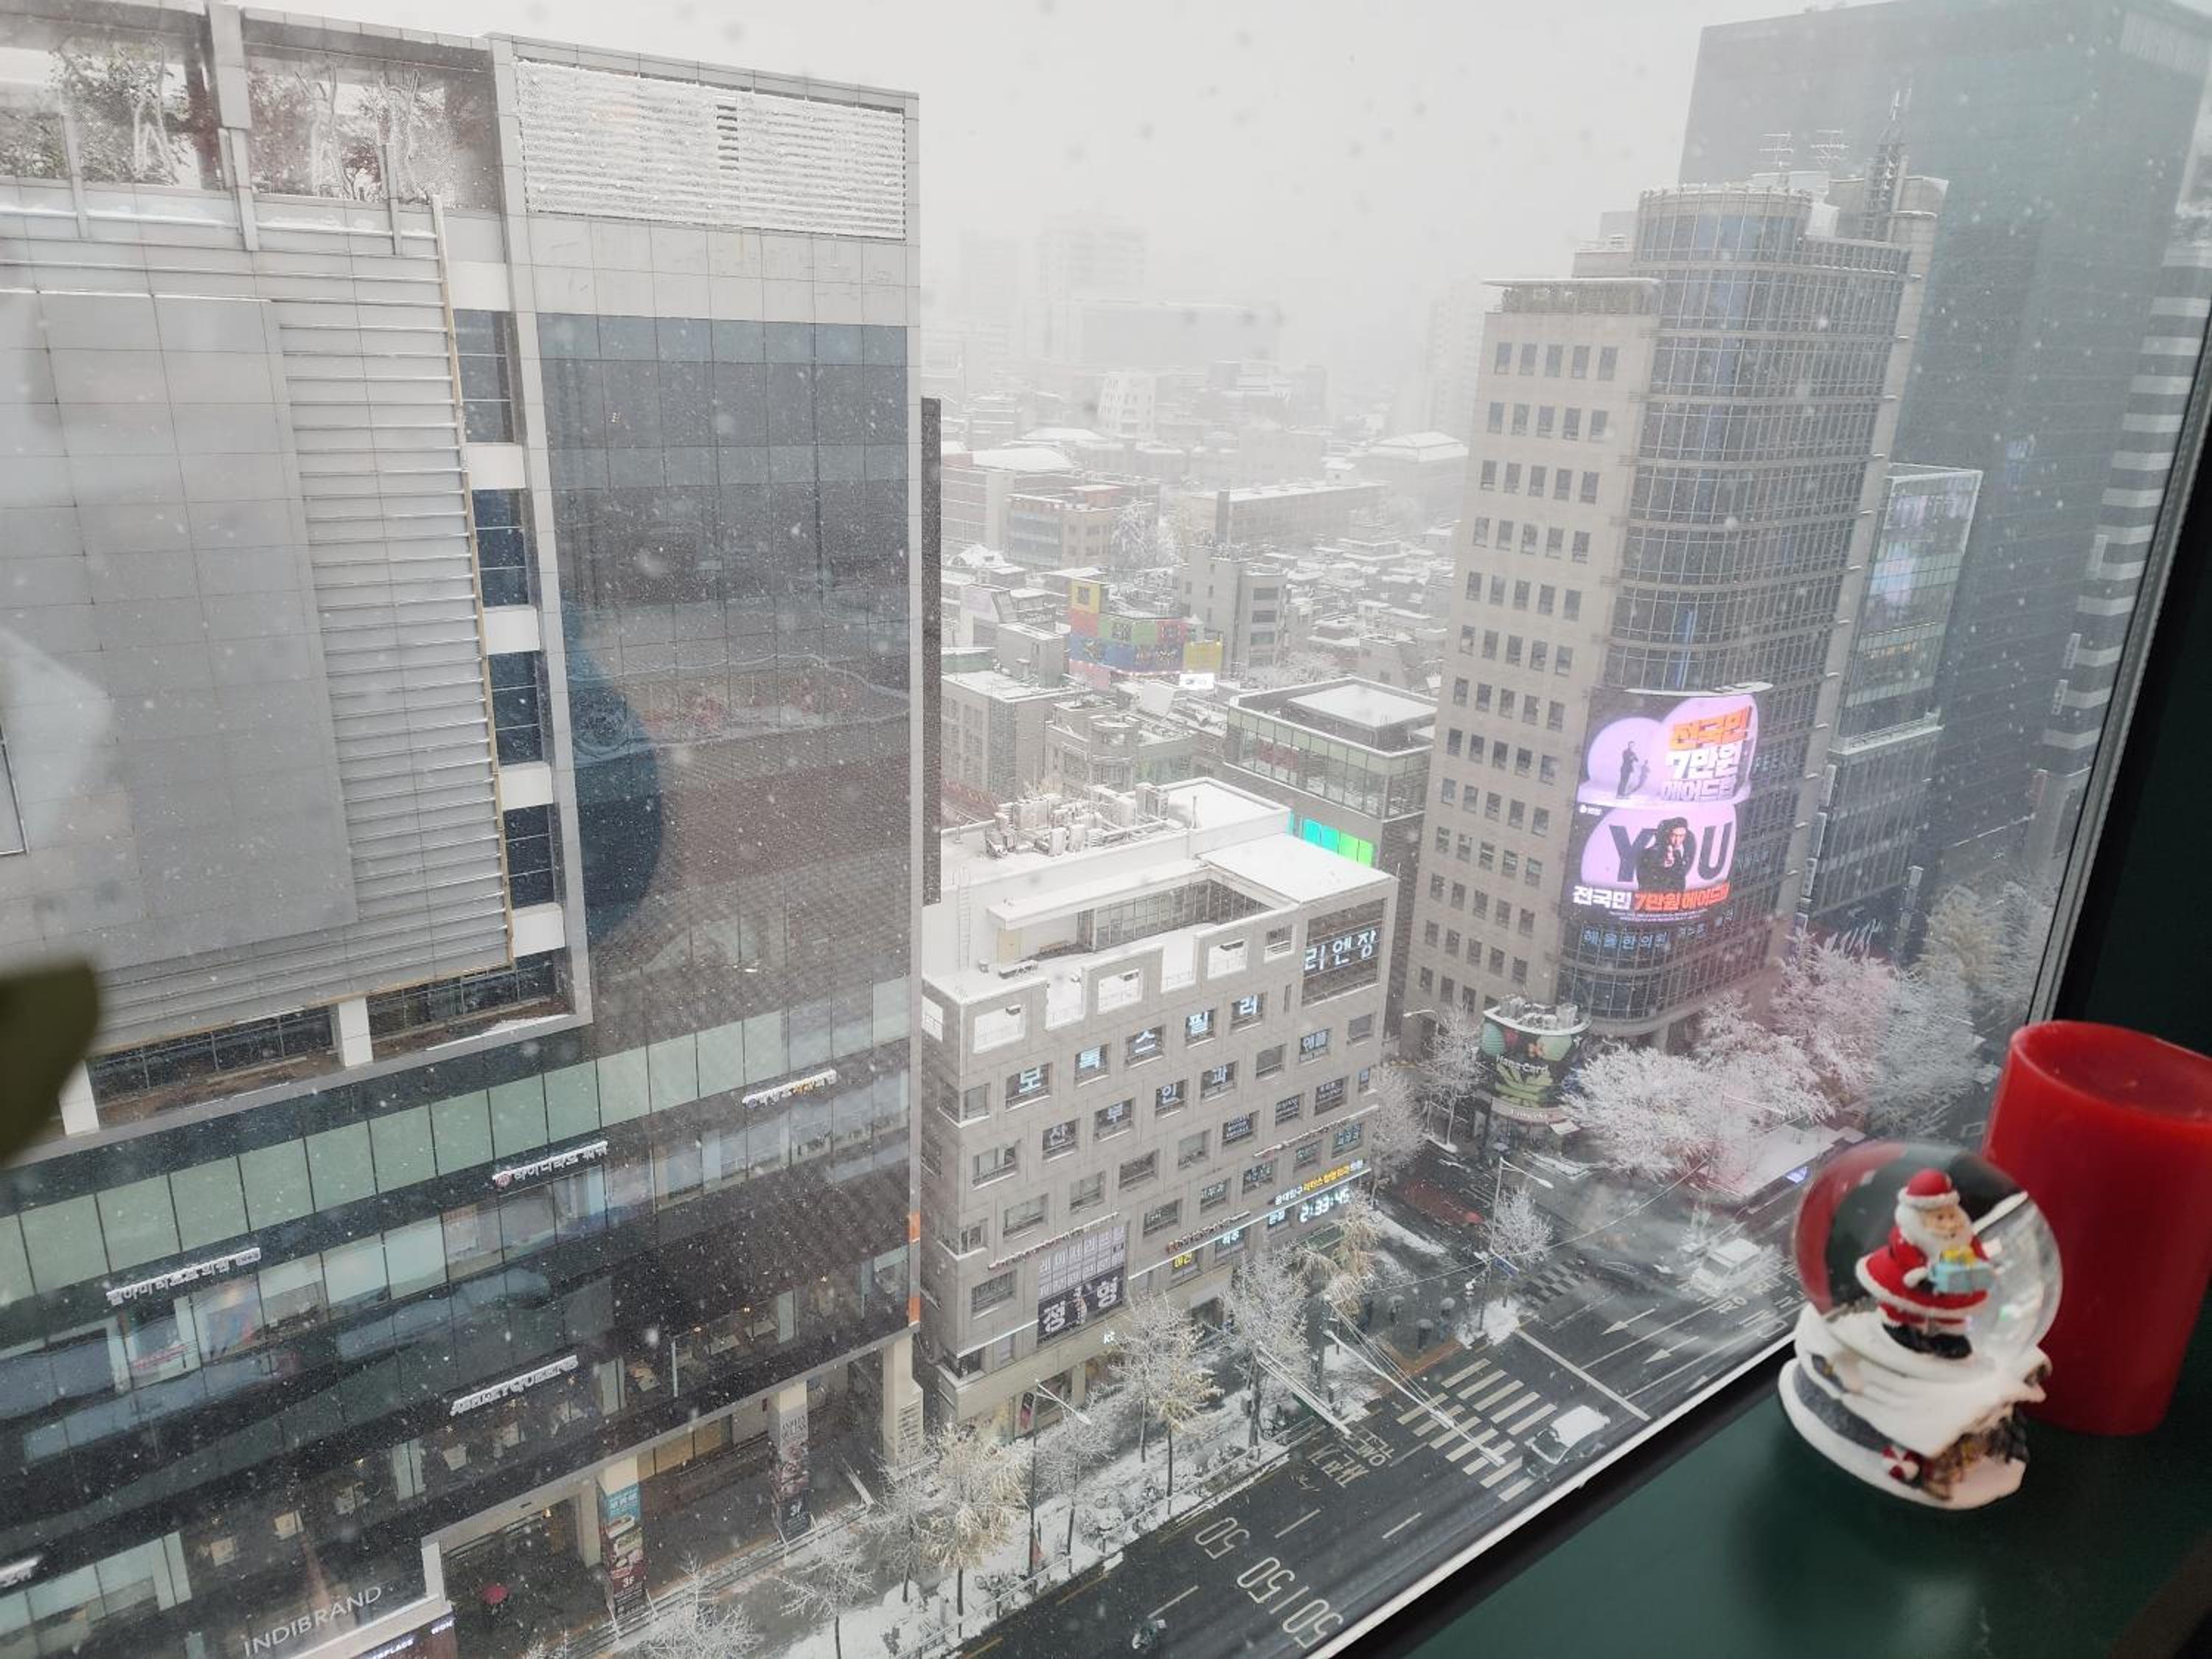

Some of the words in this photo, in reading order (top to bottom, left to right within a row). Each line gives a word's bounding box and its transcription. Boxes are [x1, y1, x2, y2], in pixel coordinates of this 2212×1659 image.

[1573, 885, 1632, 911] 전국민
[1304, 926, 1379, 973] 리엔장
[1236, 1556, 1296, 1604] 50
[243, 1585, 382, 1658] INDIBRAND
[1281, 1597, 1344, 1649] 50
